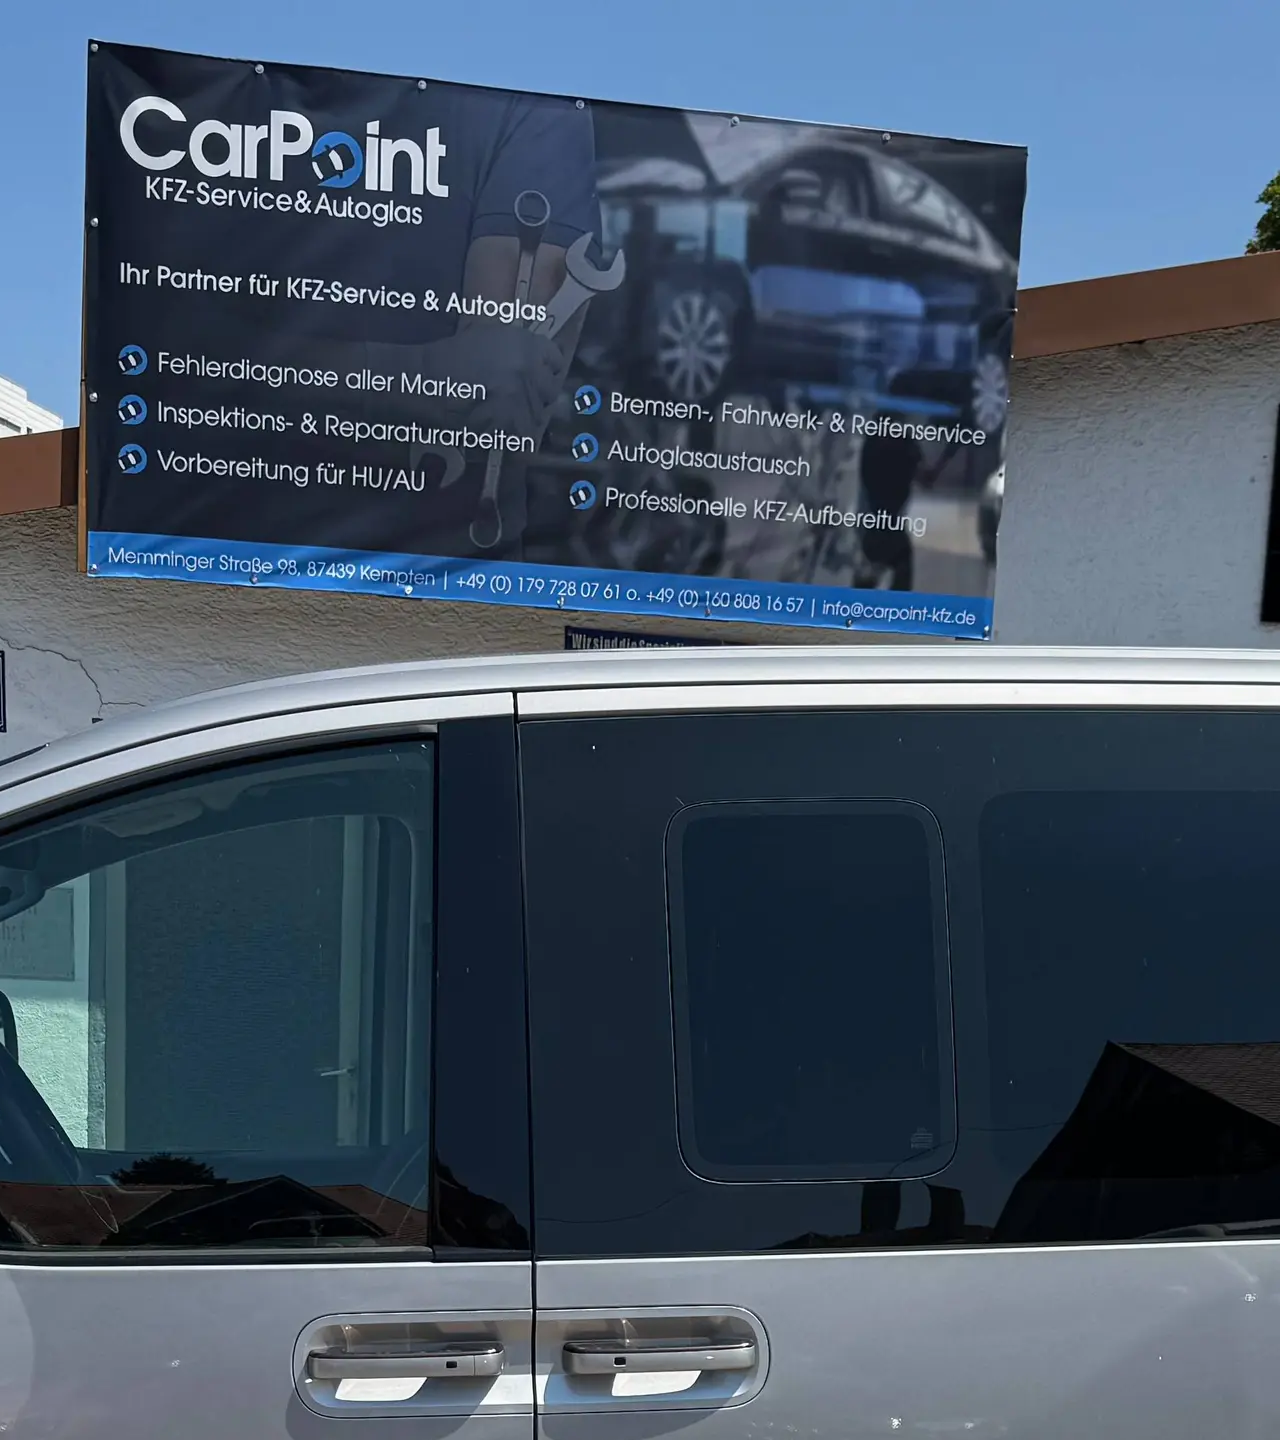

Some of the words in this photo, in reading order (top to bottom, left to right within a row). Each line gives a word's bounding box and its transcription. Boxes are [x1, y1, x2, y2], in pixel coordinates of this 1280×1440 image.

[119, 263, 149, 288] Ihr
[157, 266, 241, 294] Partner
[249, 273, 279, 297] für
[286, 277, 416, 310] KFZ-Service
[423, 290, 440, 312] &
[446, 292, 548, 325] Autoglas
[157, 352, 339, 388] Fehlerdiagnose
[345, 368, 395, 393] aller
[400, 373, 487, 401] Marken
[157, 401, 294, 433] Inspektions-
[300, 412, 319, 435] &
[325, 415, 536, 454] Reparaturarbeiten
[610, 392, 714, 423] Bremsen-,
[721, 403, 824, 433] Fahrwerk-
[829, 413, 846, 434] &
[851, 414, 987, 446] Reifenservice
[157, 450, 309, 488] Vorbereitung
[316, 462, 345, 486] für
[351, 466, 426, 493] HU/AU
[607, 439, 811, 478] Autoglasaustausch
[605, 487, 747, 519] Professionelle
[753, 500, 928, 538] KFZ-Aufbereitung
[108, 547, 215, 572] Memminger
[219, 554, 273, 574] Straße
[277, 558, 301, 577] 98,
[306, 561, 356, 580] 87439
[360, 564, 436, 587] Kempten
[456, 573, 486, 590] +49
[489, 575, 512, 595] (0)
[518, 577, 544, 594] 179
[549, 579, 577, 597] 728
[580, 582, 600, 598] 07
[603, 584, 620, 600] 61
[626, 588, 641, 601] o.
[646, 588, 675, 603] +49
[677, 589, 699, 608] (0)
[705, 590, 731, 608] 160
[733, 593, 761, 610] 808
[766, 595, 783, 612] 16
[786, 597, 804, 613] 57
[822, 600, 977, 626] info@carpoint-kfz.de
